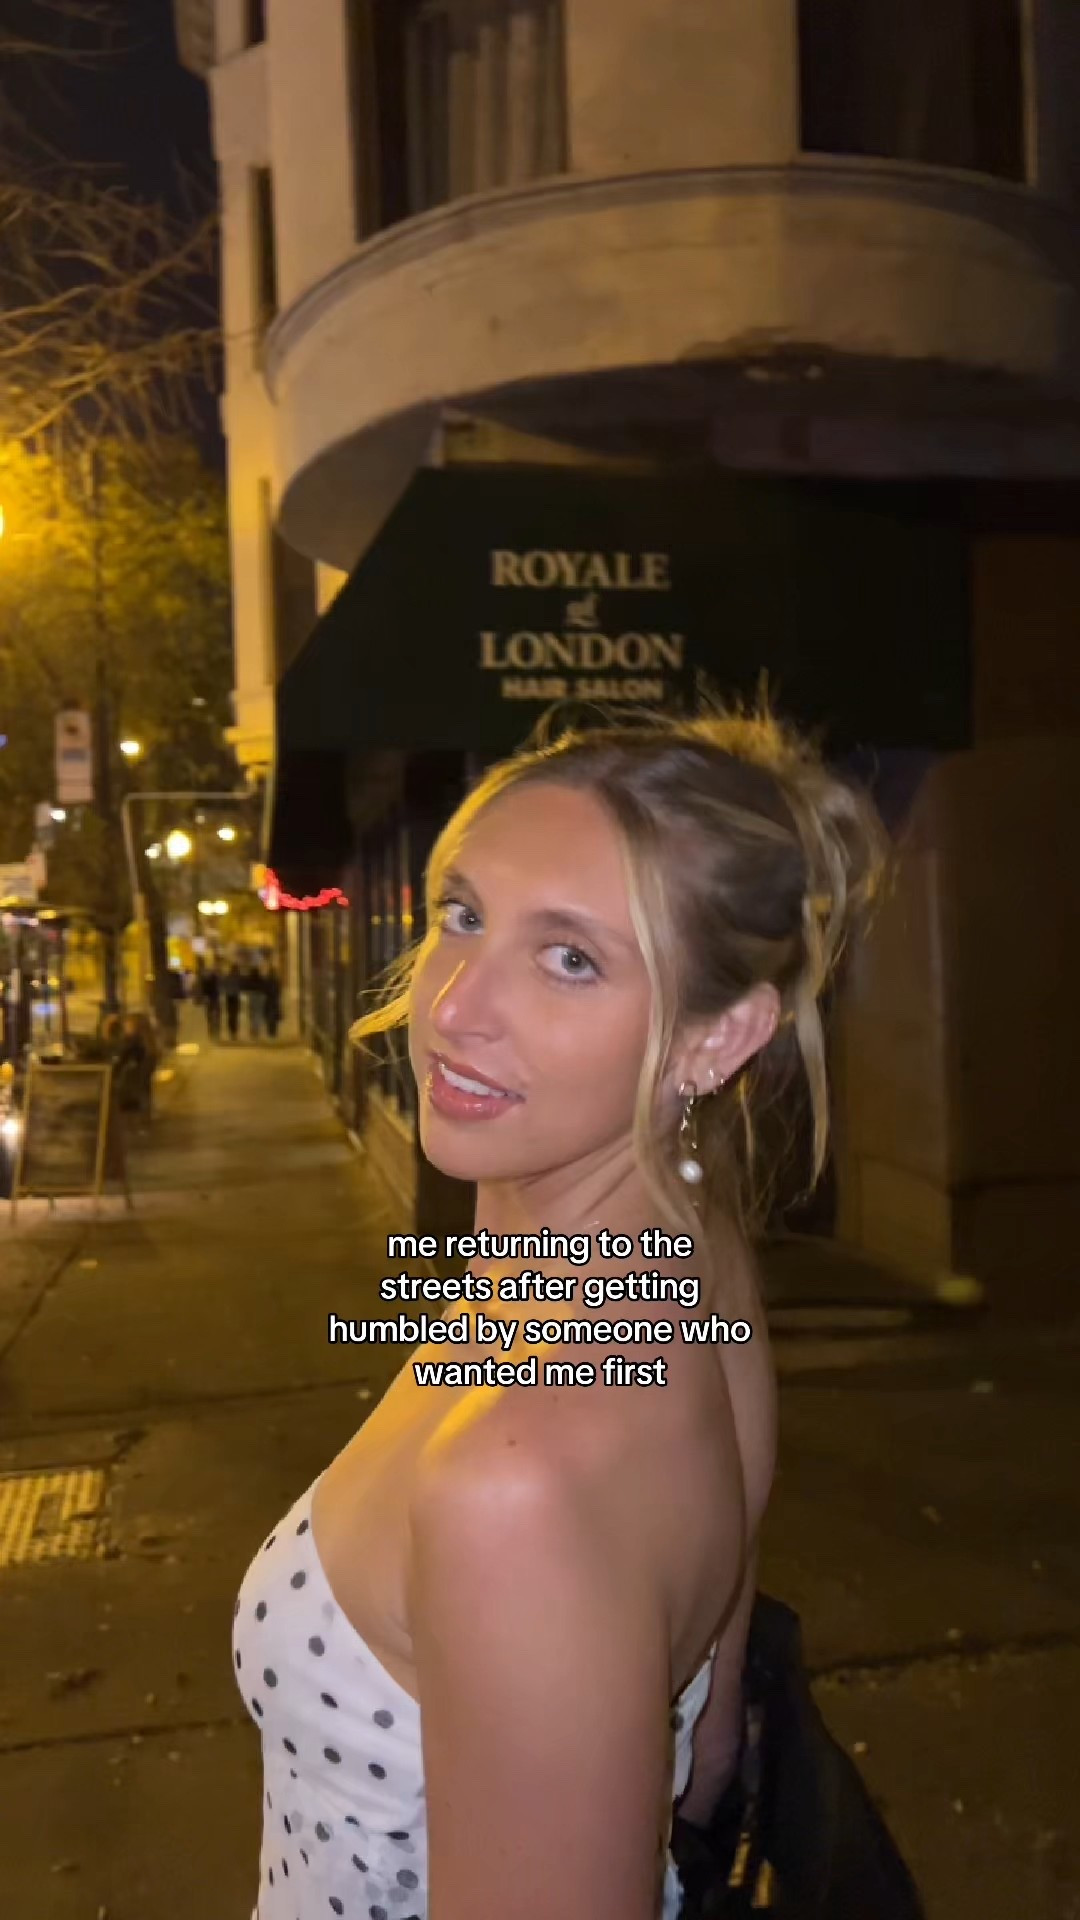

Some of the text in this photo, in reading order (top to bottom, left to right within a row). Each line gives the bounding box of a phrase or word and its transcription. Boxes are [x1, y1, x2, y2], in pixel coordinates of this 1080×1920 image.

[491, 550, 671, 589] ROYALE
[480, 632, 685, 669] LONDON
[502, 677, 664, 700] HAIR SALON
